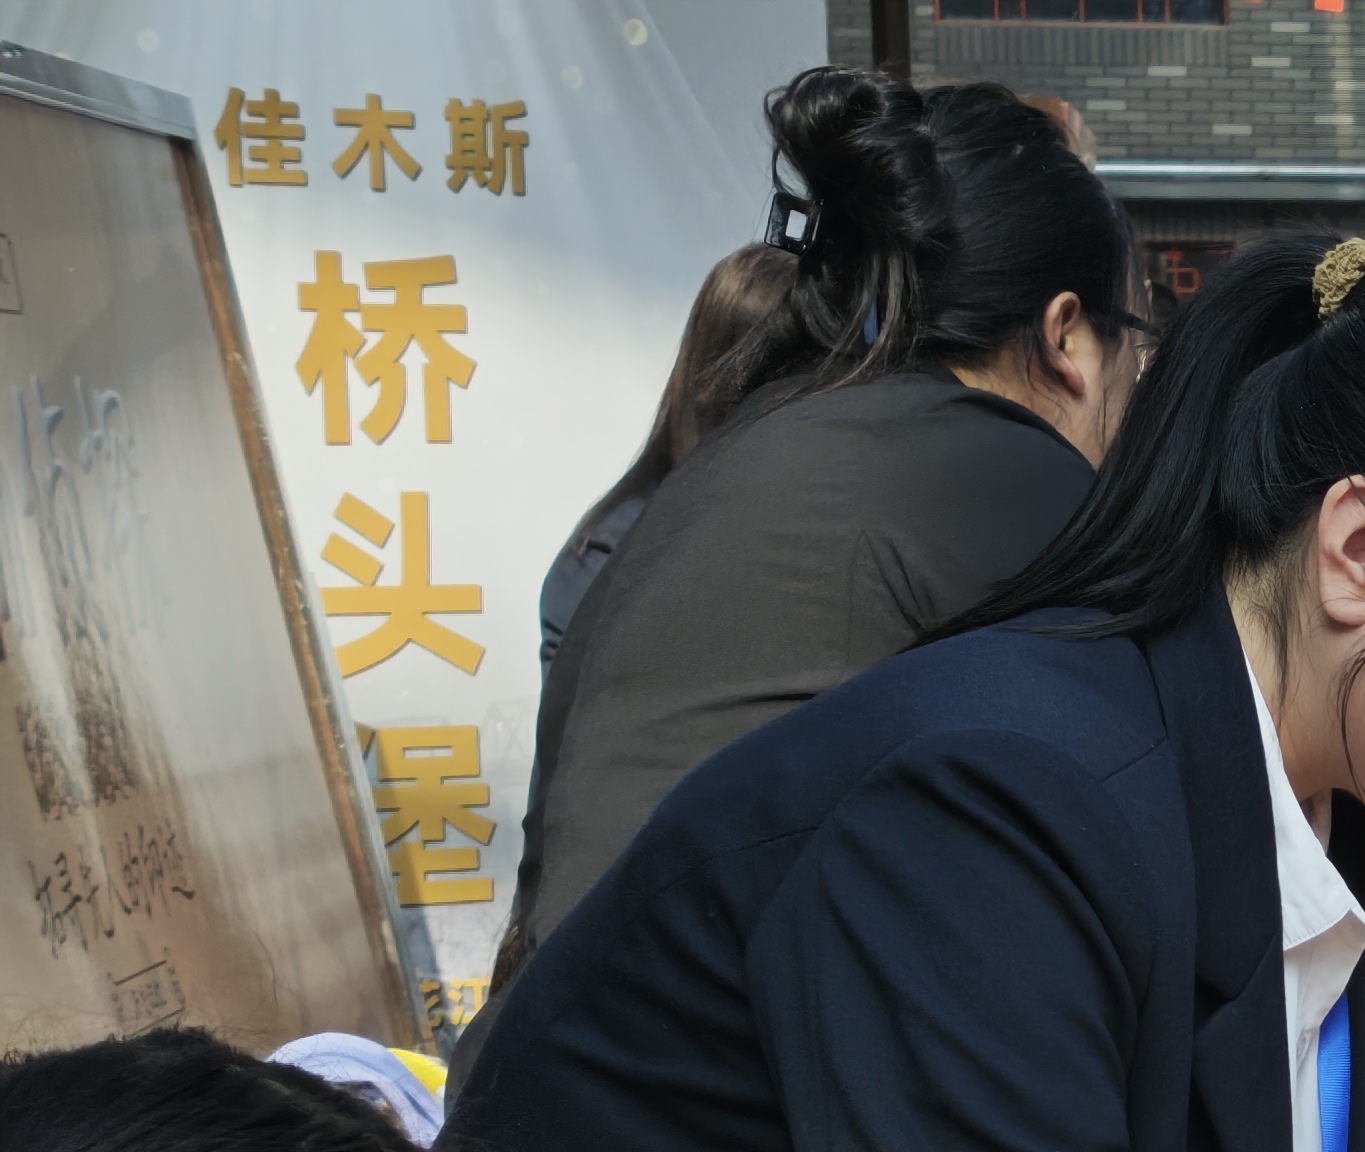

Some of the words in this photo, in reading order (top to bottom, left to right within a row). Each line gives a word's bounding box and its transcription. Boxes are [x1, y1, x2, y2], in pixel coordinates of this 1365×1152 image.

[214, 86, 530, 196] 佳木斯
[295, 250, 497, 908] 桥头堡
